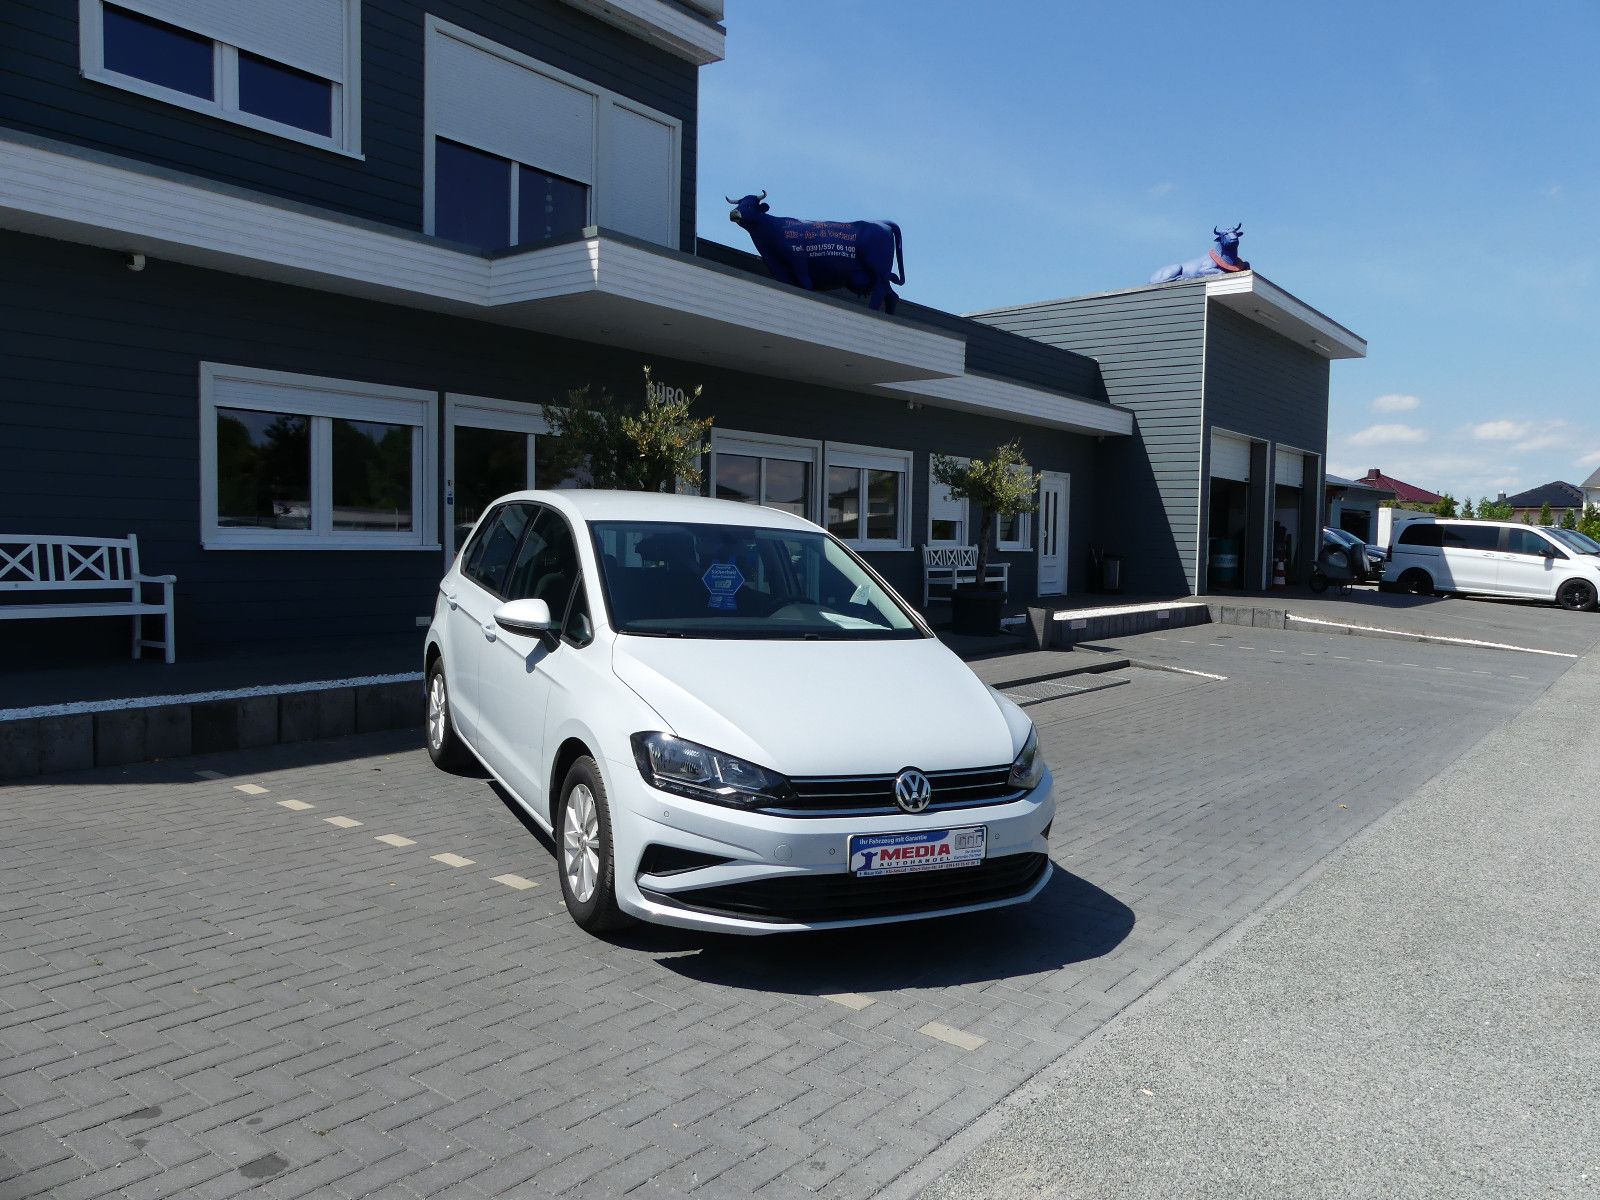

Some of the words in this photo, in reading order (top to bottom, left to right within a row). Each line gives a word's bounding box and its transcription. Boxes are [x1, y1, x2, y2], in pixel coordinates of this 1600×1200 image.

[868, 837, 895, 845] Fahrzeug
[879, 843, 951, 861] MEDIA
[879, 856, 951, 867] AUTOHANDEL
